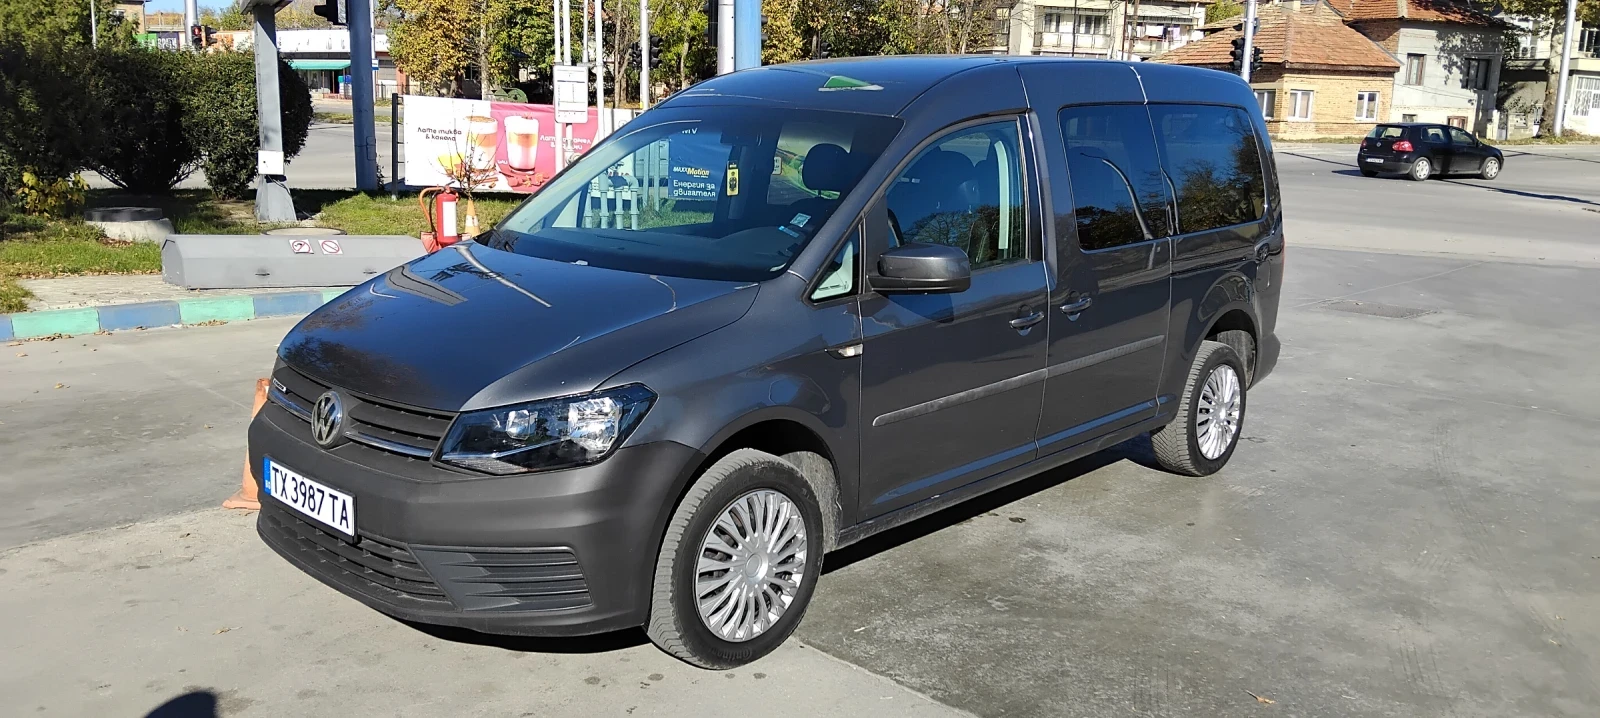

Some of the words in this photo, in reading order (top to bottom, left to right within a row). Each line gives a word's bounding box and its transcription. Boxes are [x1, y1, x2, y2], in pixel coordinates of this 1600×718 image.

[673, 179, 705, 190] Енергия
[706, 183, 716, 191] за
[271, 466, 288, 501] TX
[290, 476, 325, 516] 3987
[328, 492, 349, 529] TA
